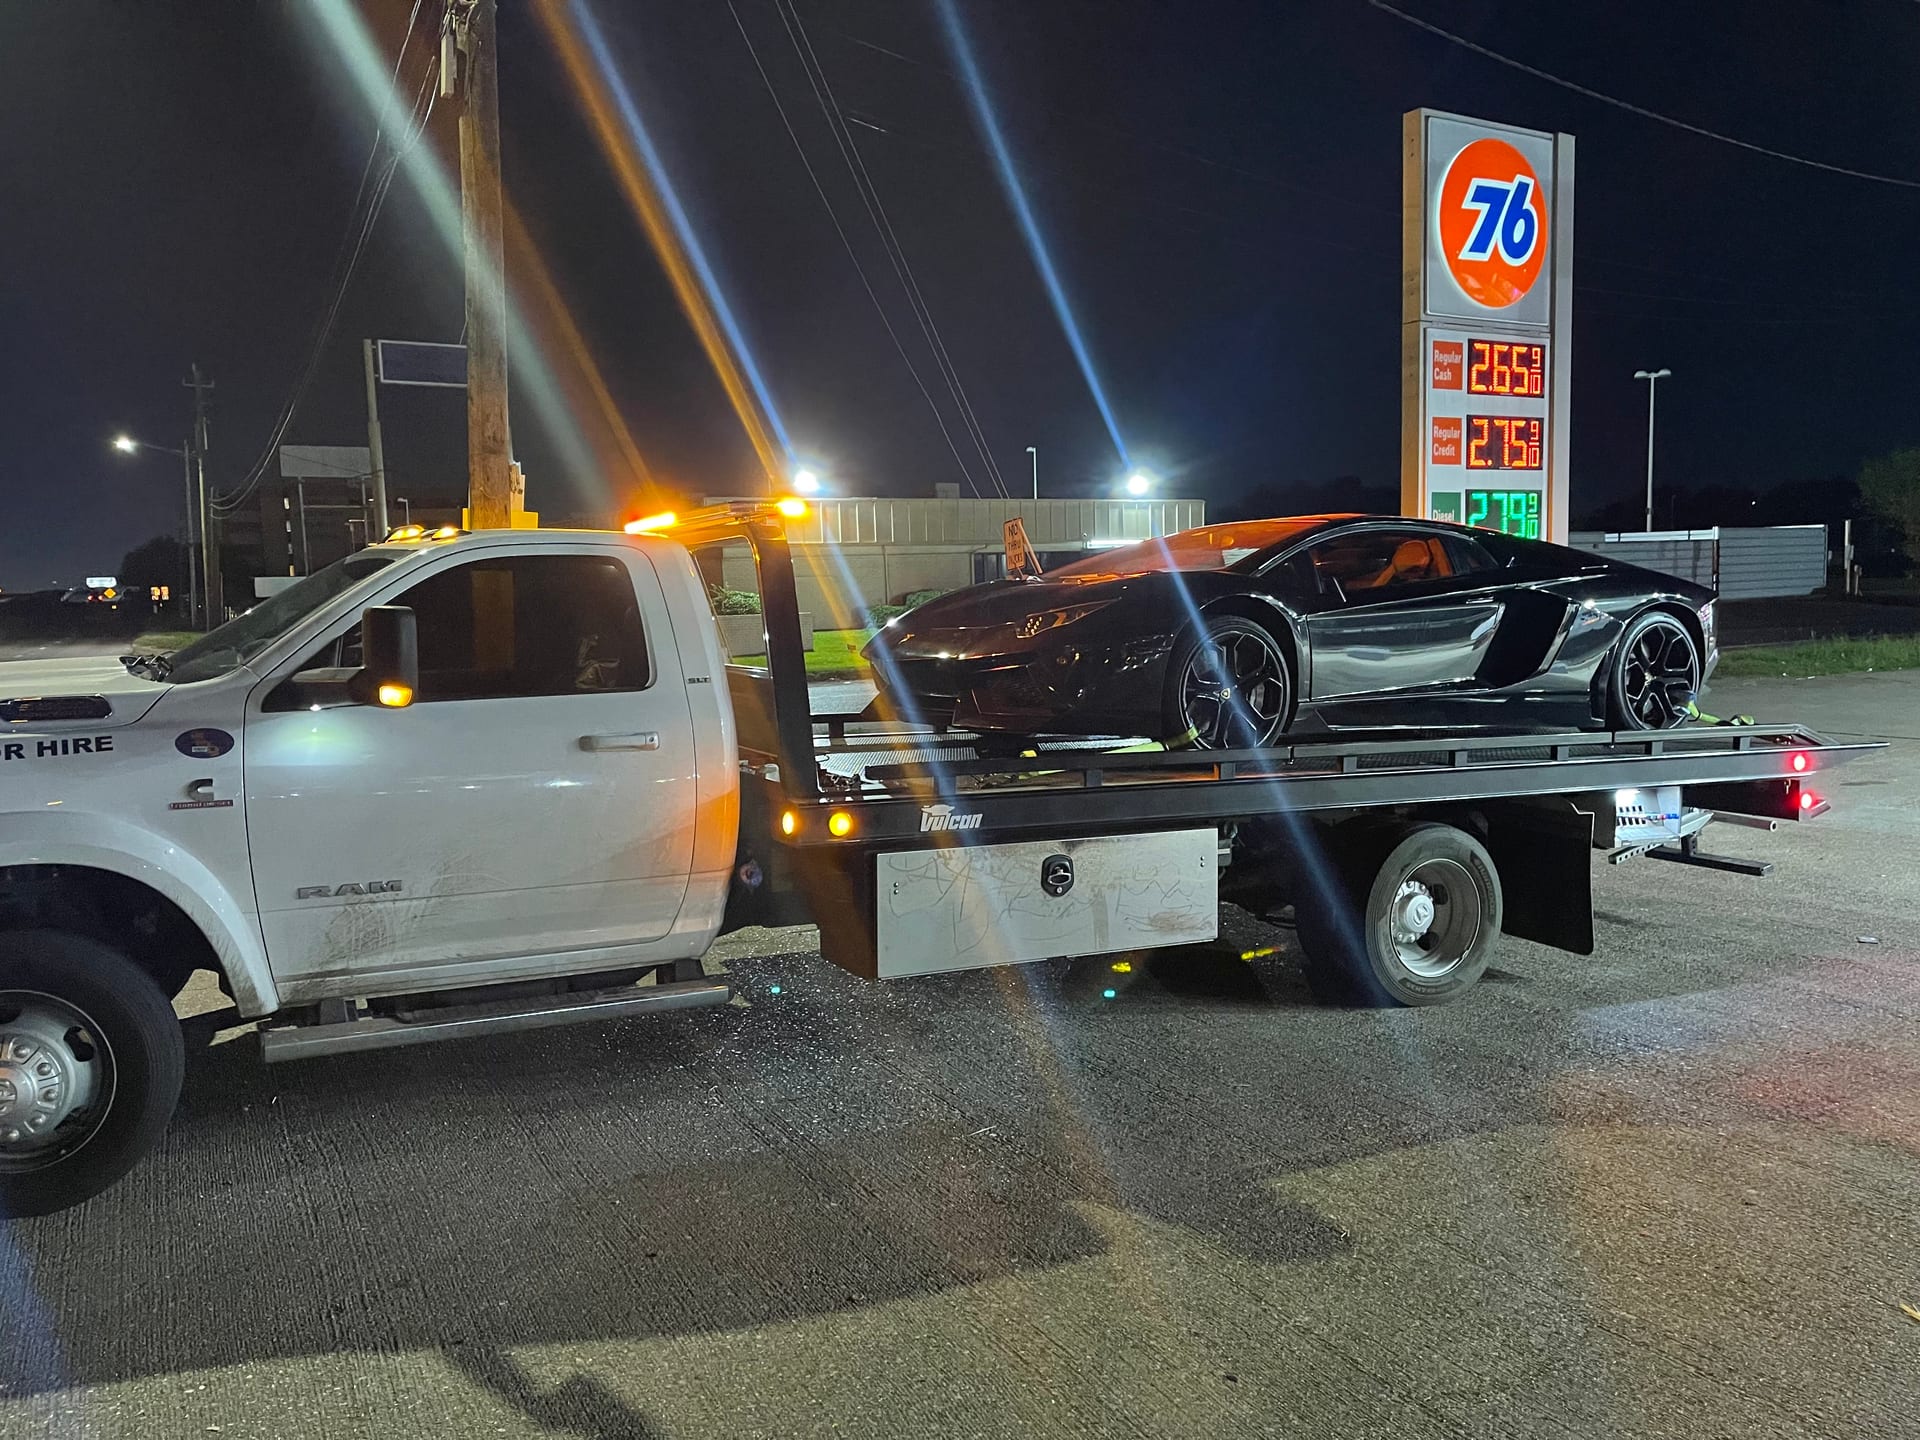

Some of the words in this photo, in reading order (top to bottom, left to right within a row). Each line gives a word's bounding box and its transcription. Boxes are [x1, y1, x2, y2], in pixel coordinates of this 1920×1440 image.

[1460, 176, 1537, 265] 76
[1434, 350, 1462, 366] Regular
[1434, 367, 1452, 381] Cash
[1471, 343, 1528, 394] 2.65
[1433, 426, 1461, 441] Regular
[1470, 418, 1527, 467] 2.75
[1433, 444, 1455, 457] Credit
[1433, 509, 1455, 522] Diesel
[1008, 523, 1018, 537] NO
[688, 677, 711, 685] SLT
[0, 744, 25, 760] R
[37, 736, 113, 758] HIRE
[297, 880, 402, 899] RAM
